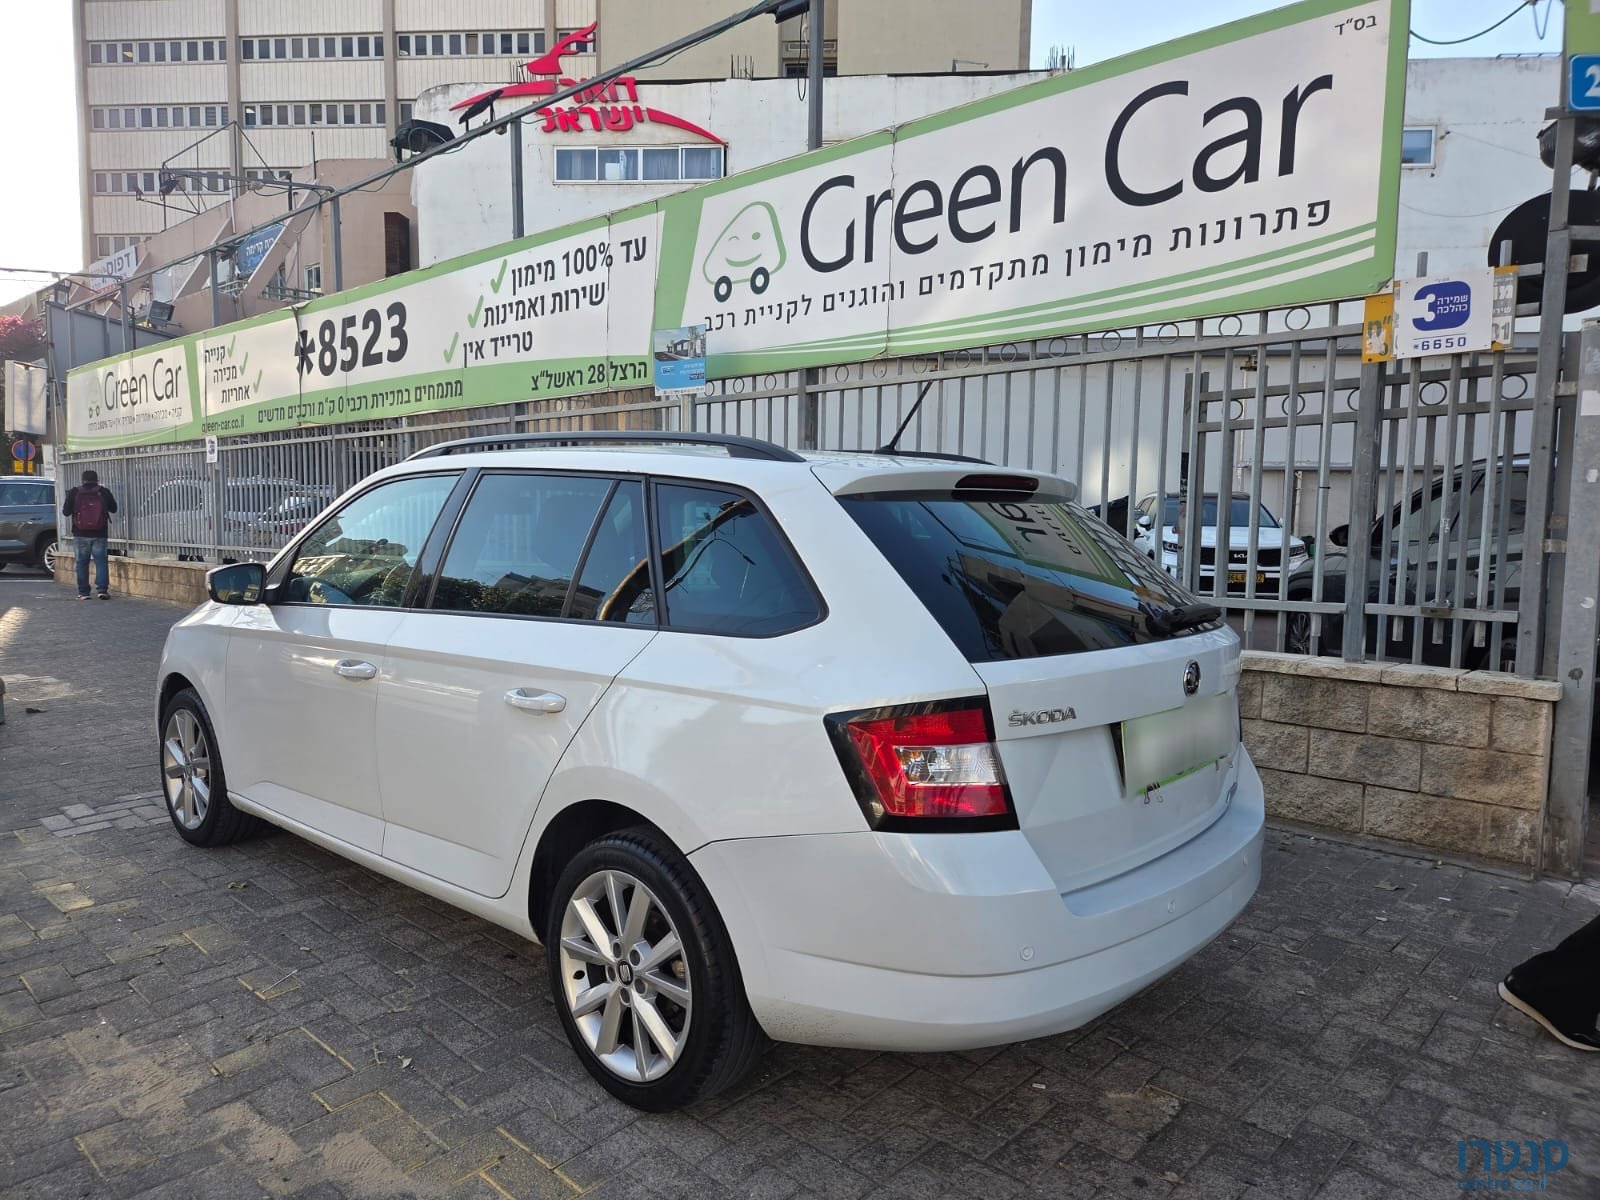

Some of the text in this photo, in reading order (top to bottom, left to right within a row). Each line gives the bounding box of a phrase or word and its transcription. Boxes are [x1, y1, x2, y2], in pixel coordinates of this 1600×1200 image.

[1334, 15, 1377, 36] בס"ד
[535, 105, 645, 132] ישראל
[801, 73, 1333, 273] Green Car
[106, 253, 130, 275] דפוס
[511, 236, 647, 296] עד 100% מימון
[704, 199, 1331, 333] פתרונות מימון מתקדמים והוגנים לקניית רכב
[483, 282, 606, 328] שירות ואמינות
[1436, 294, 1468, 306] שמירה
[1436, 304, 1468, 315] כהלכה
[463, 331, 533, 368] טרייד אין
[104, 358, 182, 411] Green Car
[213, 365, 238, 384] מכירה
[531, 361, 648, 391] הרצל 28 ראשל"צ
[221, 384, 250, 404] אחריות
[371, 388, 411, 409] במכירת
[414, 379, 464, 403] מתמחים
[258, 406, 285, 423] חדשים
[287, 402, 315, 420] ורכבים
[346, 395, 368, 413] רכבי
[1007, 706, 1077, 728] ŠKODA
